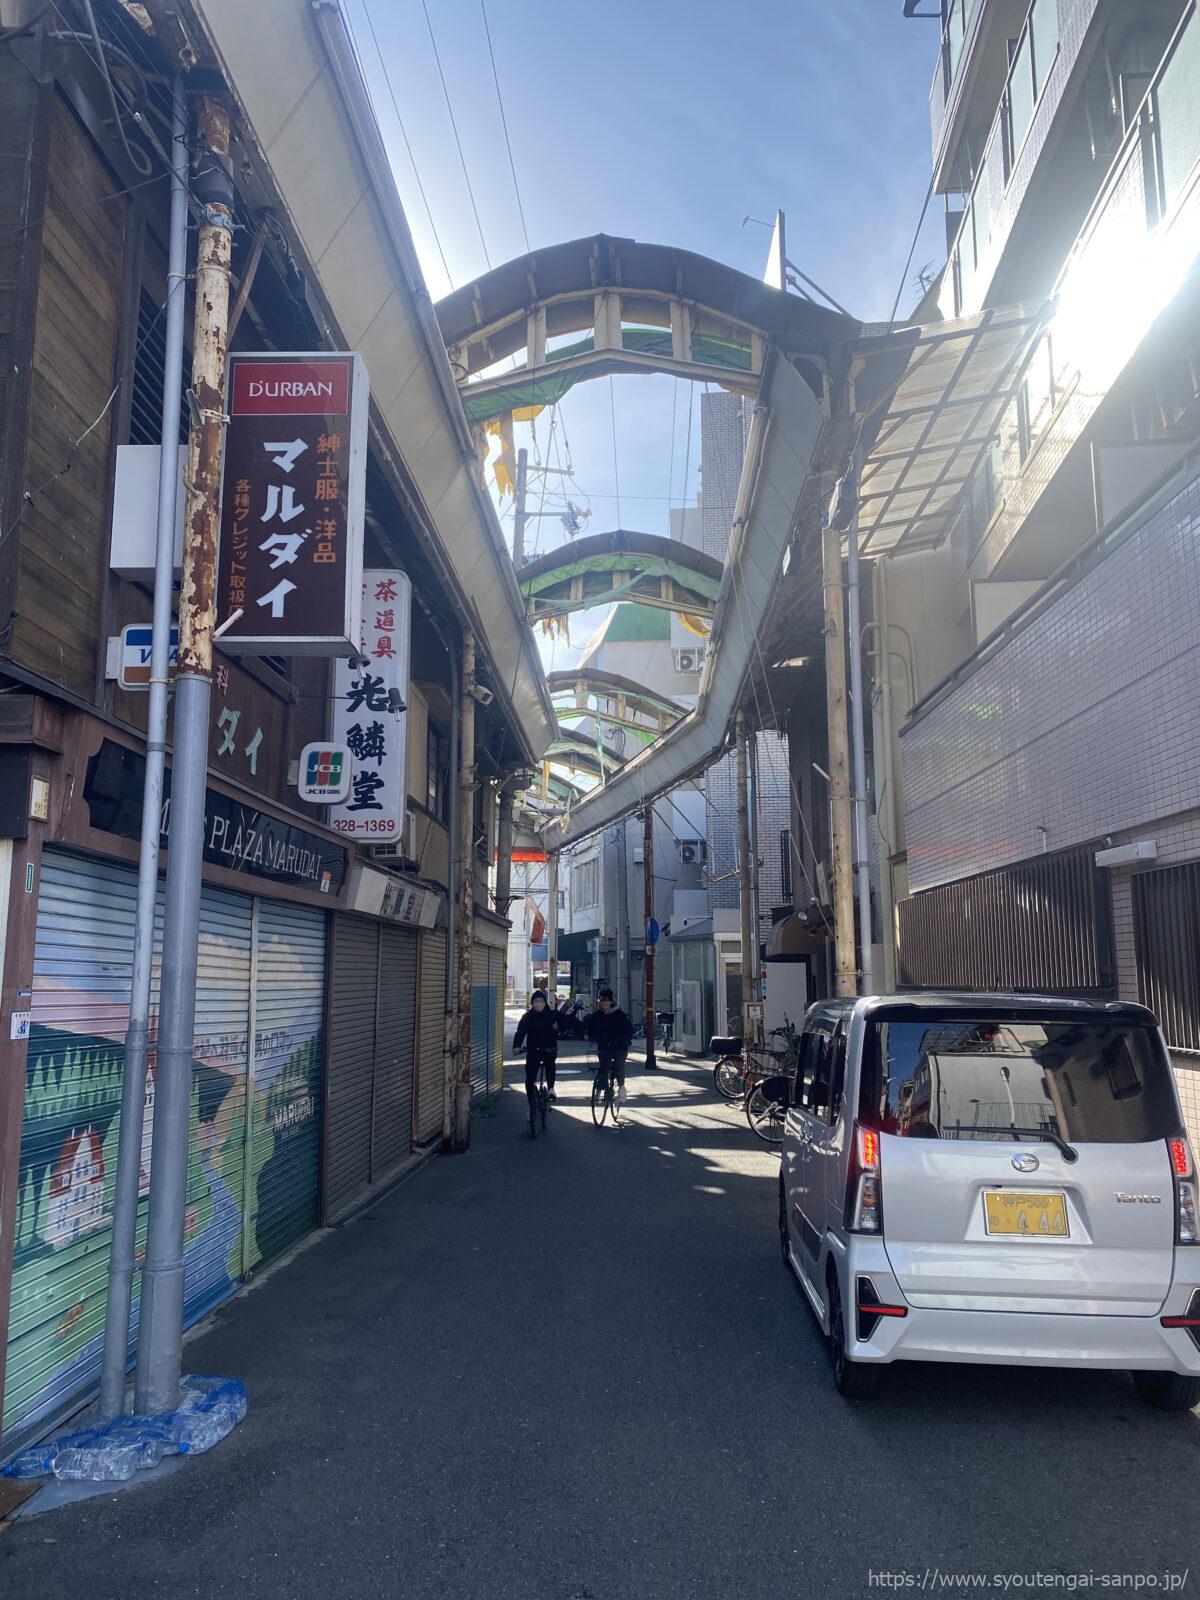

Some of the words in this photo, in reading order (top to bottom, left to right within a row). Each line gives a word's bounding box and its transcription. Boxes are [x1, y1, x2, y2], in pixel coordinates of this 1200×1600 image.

[256, 438, 313, 618] マルダイ
[313, 433, 340, 563] 紳士服・洋品
[371, 578, 398, 659] 茶道具
[308, 764, 341, 773] JCB
[209, 815, 263, 865] PLAZA
[265, 838, 322, 881] MARUDAI
[333, 819, 395, 833] 328-1369
[1112, 1191, 1162, 1204] Tanto
